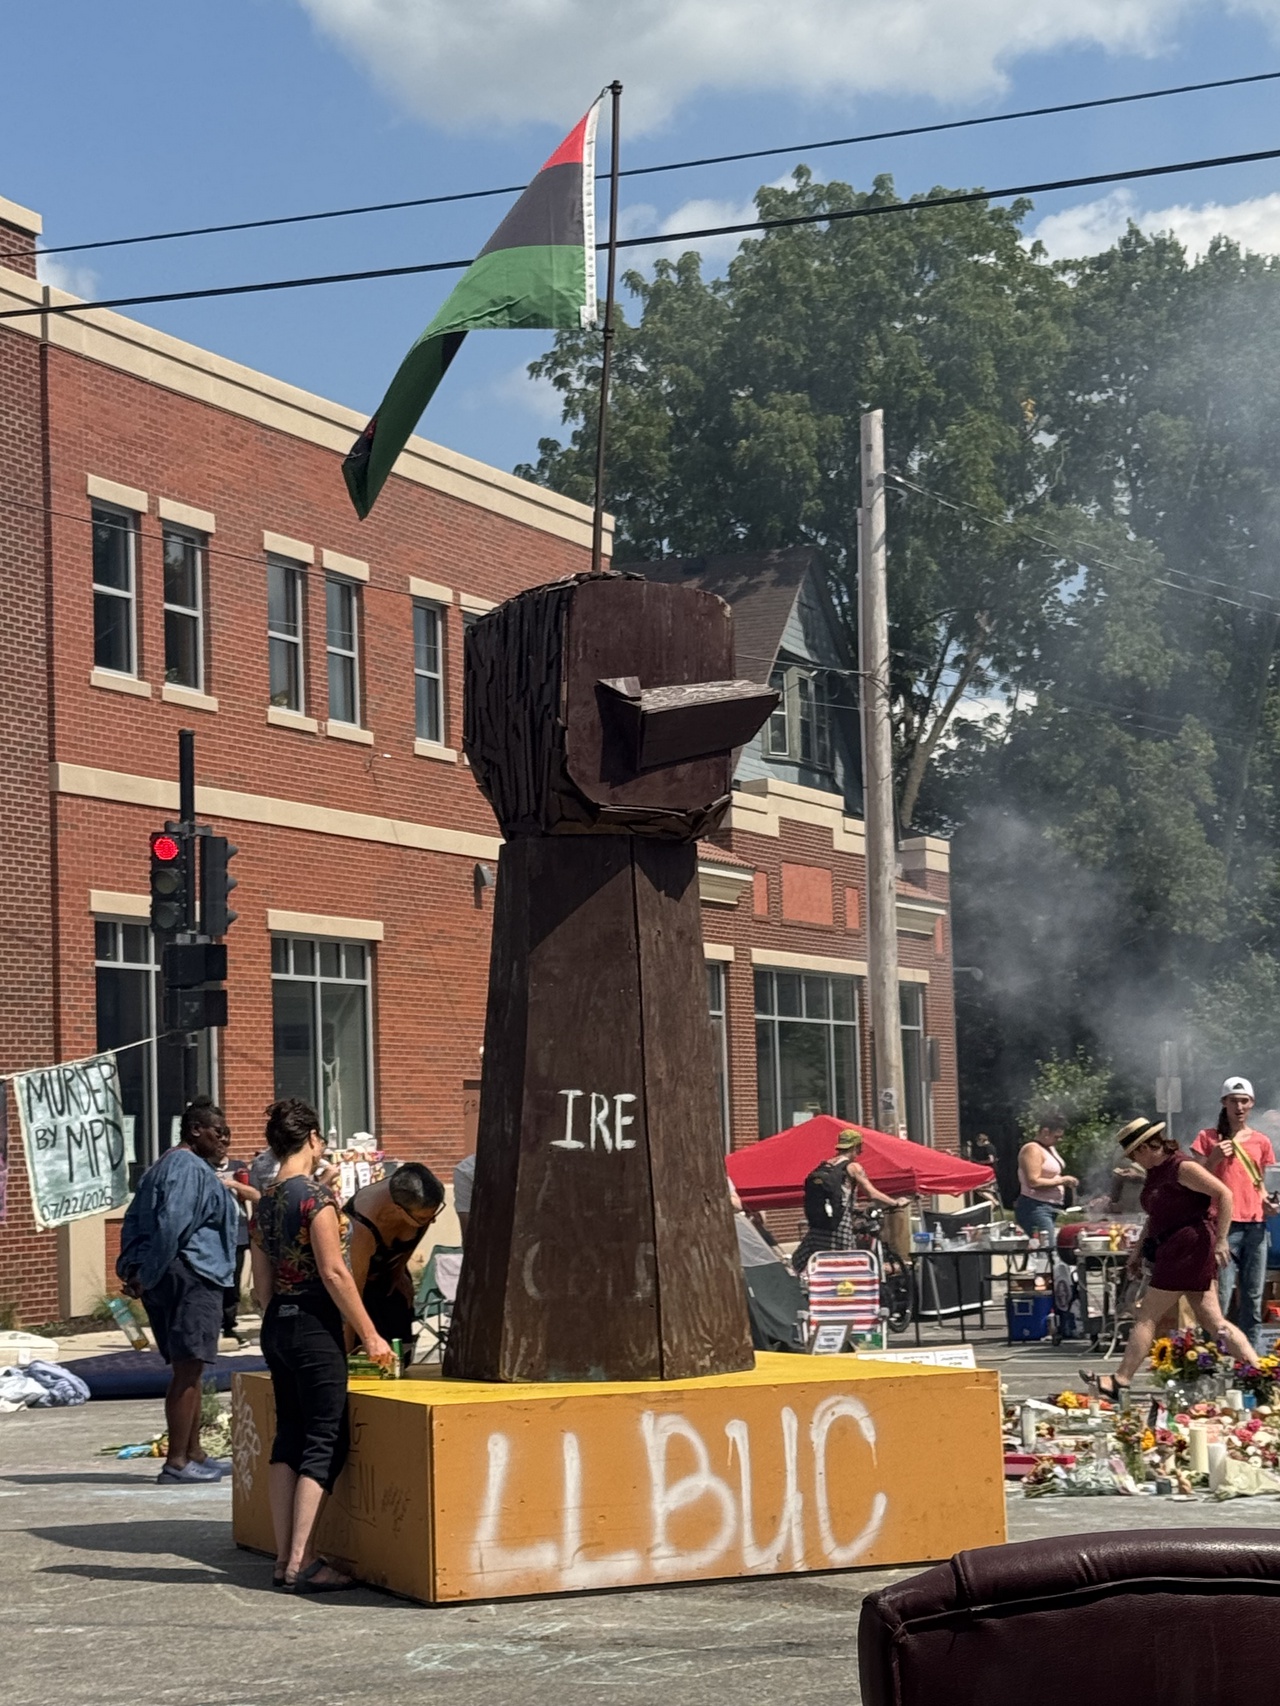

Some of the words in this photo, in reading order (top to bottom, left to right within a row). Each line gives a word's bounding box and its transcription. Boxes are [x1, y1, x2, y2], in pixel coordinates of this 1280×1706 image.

[36, 1123, 57, 1150] BY
[66, 1117, 124, 1182] MPD
[549, 1089, 638, 1154] IRE
